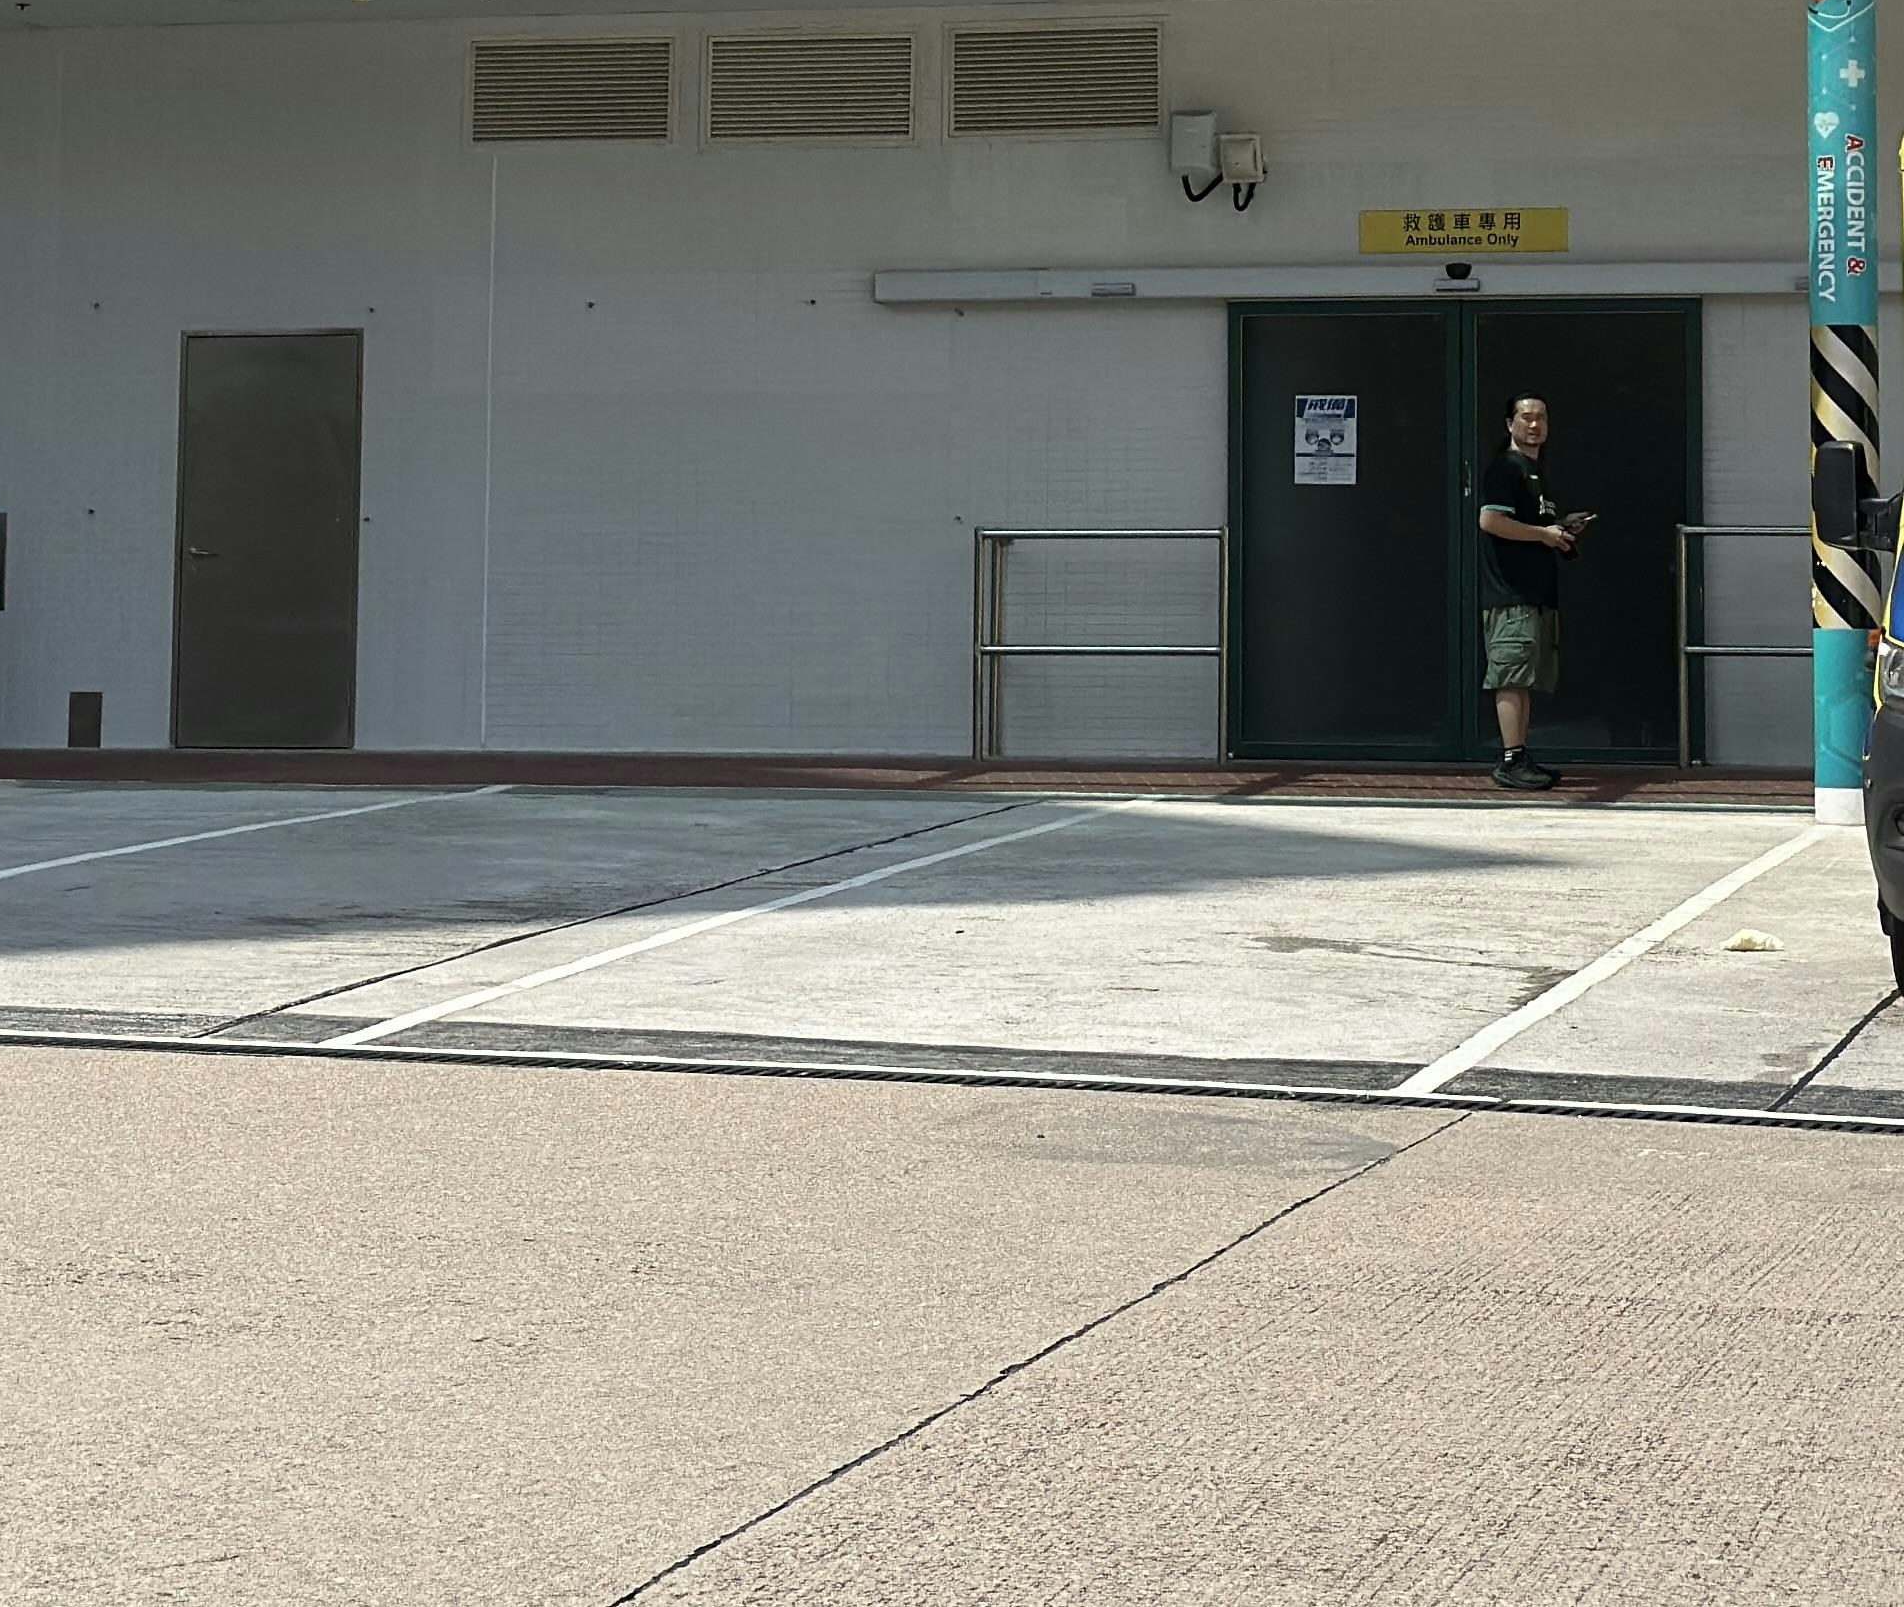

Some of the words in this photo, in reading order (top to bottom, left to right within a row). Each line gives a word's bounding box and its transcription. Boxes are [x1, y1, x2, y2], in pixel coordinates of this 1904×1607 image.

[1845, 134, 1866, 252] ACCIDENT
[1402, 212, 1521, 232] 救護車專用
[1815, 155, 1836, 302] EMERGENCY
[1405, 234, 1483, 246] Ambulance
[1487, 233, 1519, 248] Only
[1846, 253, 1867, 277] &
